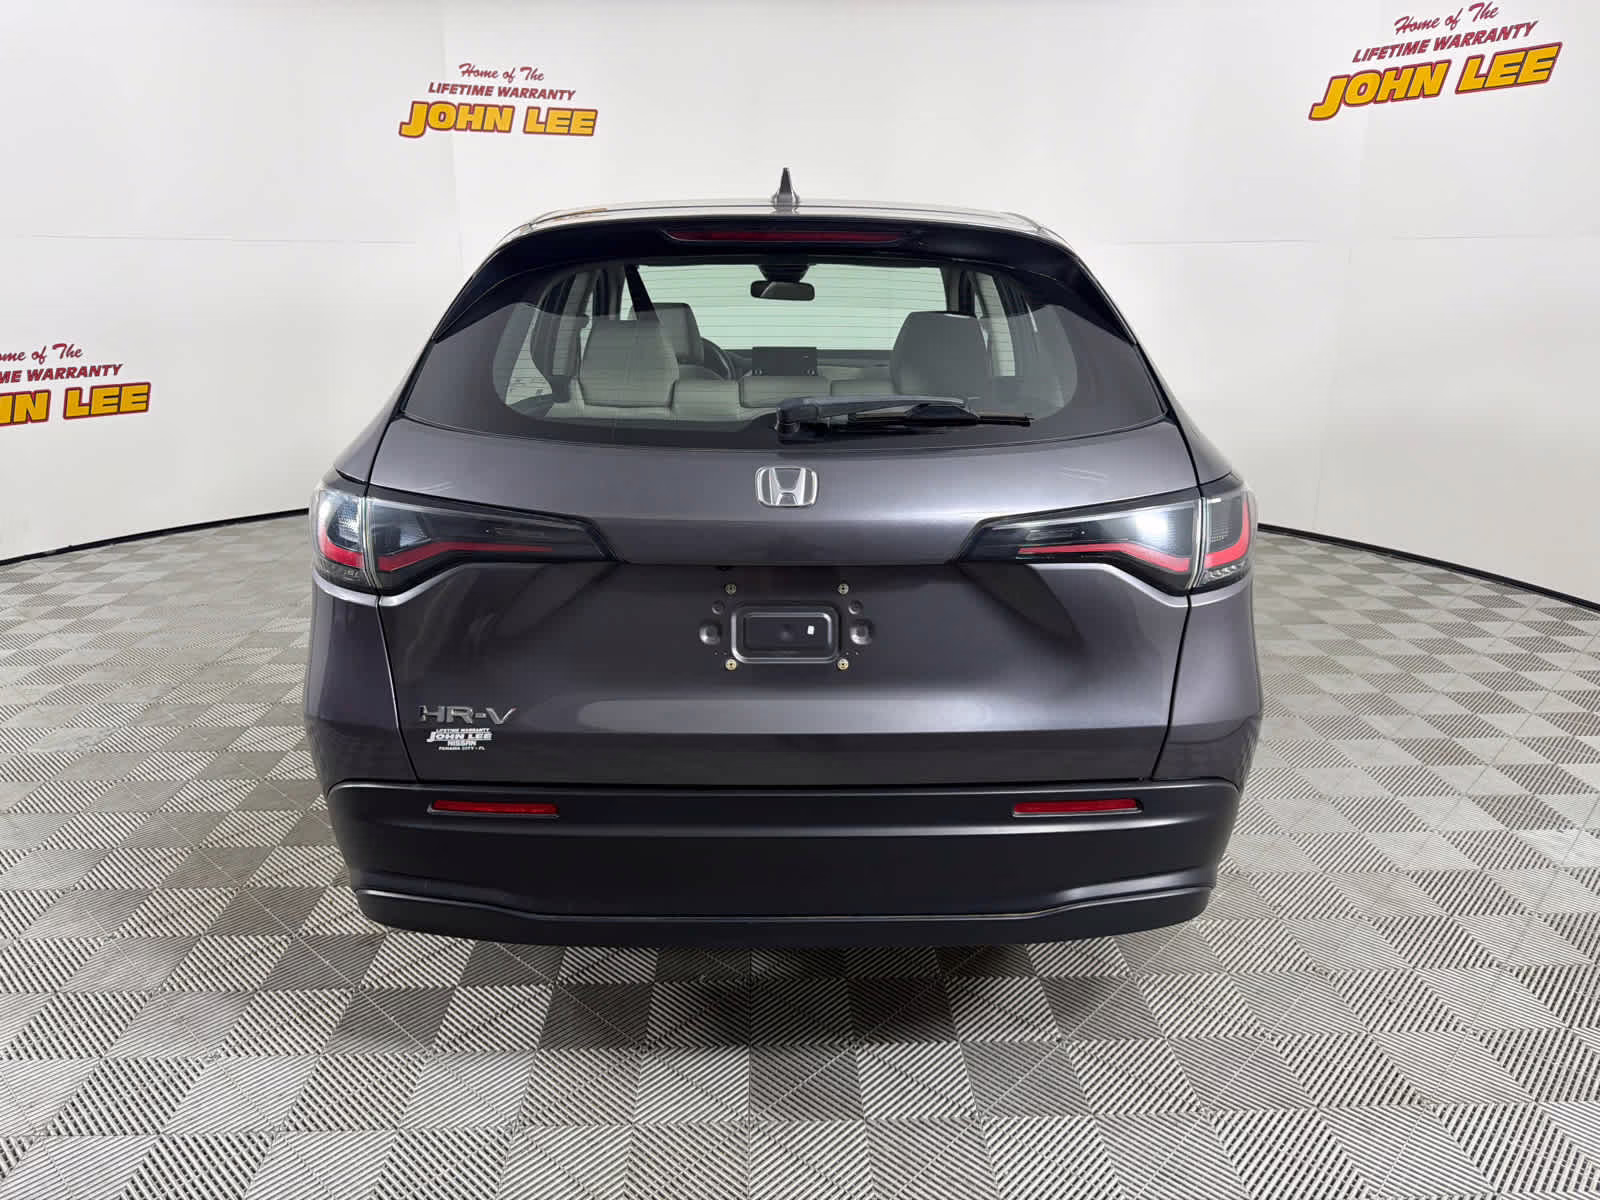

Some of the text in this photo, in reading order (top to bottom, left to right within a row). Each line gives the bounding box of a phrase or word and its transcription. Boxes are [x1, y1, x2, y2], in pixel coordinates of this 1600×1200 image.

[1394, 1, 1498, 35] Home of The
[1352, 20, 1538, 63] LIFETIME WARRANTY
[458, 62, 545, 83] Home of The
[1308, 42, 1563, 121] JOHN LEE
[428, 82, 576, 101] LIFETIME WARRANTY
[399, 100, 598, 138] JOHN LEE
[31, 346, 47, 365] of
[52, 343, 83, 359] The
[27, 363, 123, 382] WARRANTY
[62, 381, 152, 420] LEE
[419, 705, 517, 725] HR-V
[426, 731, 493, 742] JOHN LEE
